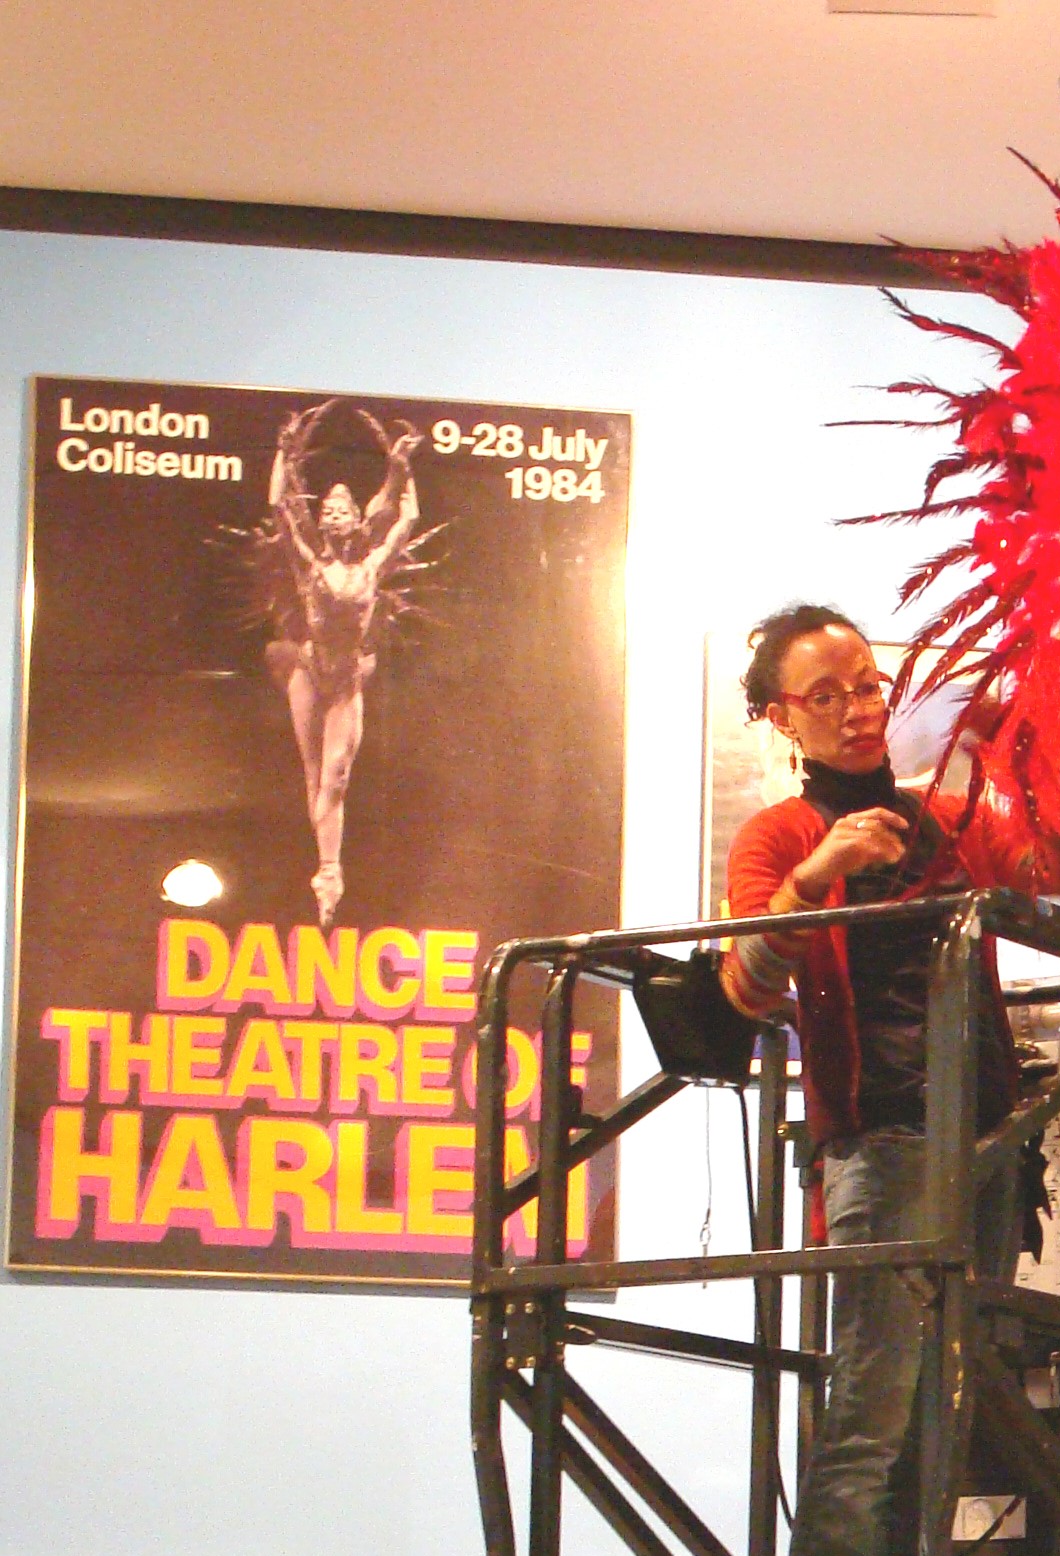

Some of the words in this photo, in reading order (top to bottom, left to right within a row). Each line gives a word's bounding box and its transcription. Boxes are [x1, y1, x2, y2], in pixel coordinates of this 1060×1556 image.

[56, 436, 243, 482] Coliseum
[504, 466, 605, 503] 1984
[58, 397, 211, 440] London
[431, 419, 524, 460] 9-28
[527, 424, 609, 470] July
[156, 917, 480, 1021] DANCE
[42, 1007, 457, 1118] THEATRE
